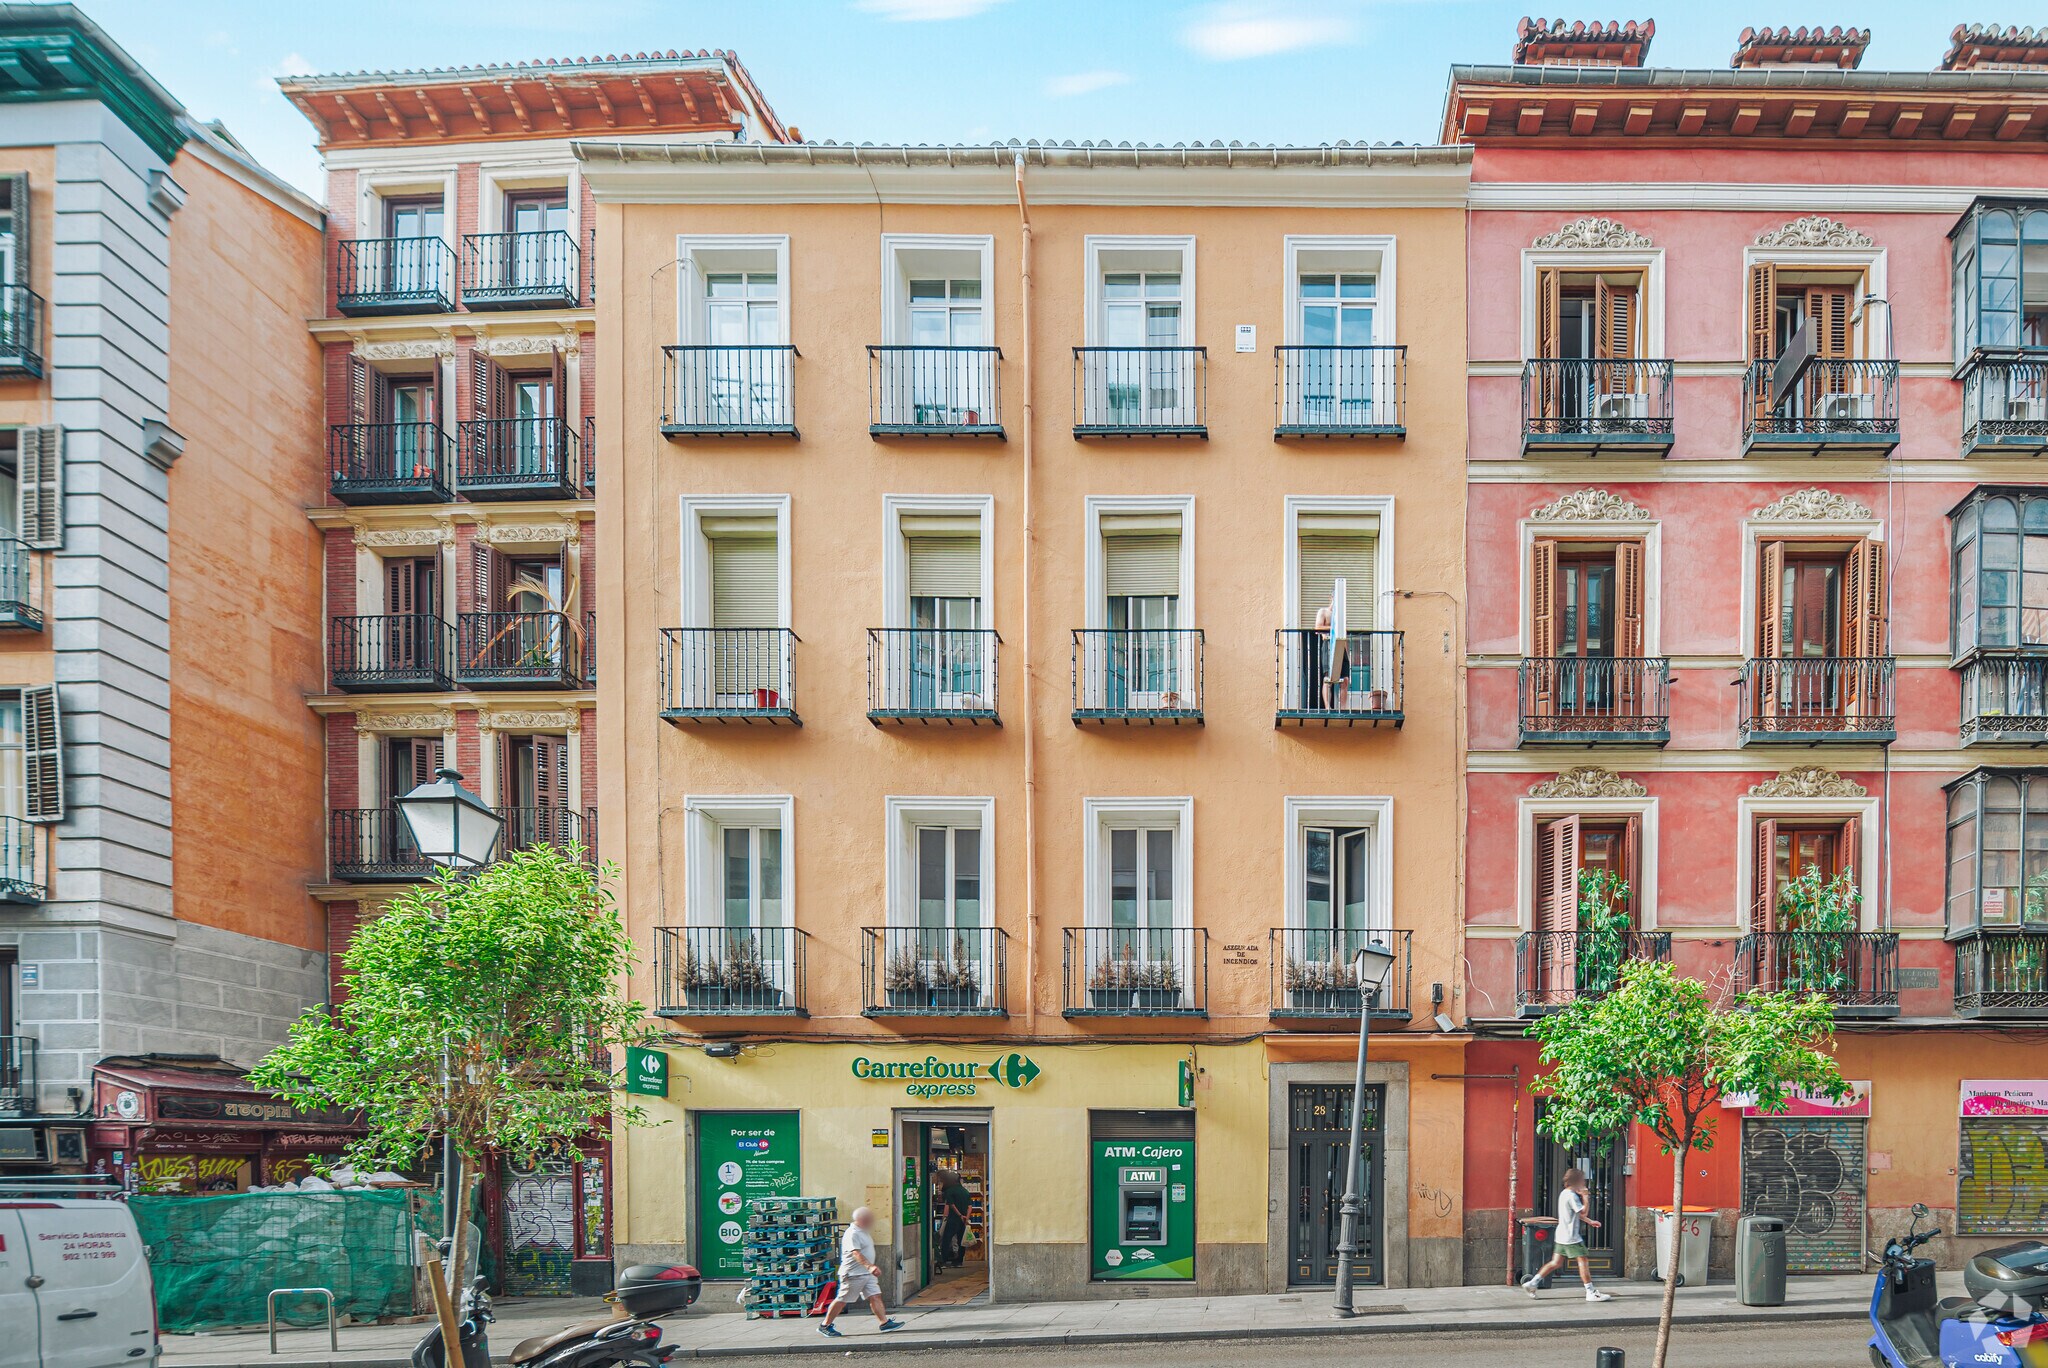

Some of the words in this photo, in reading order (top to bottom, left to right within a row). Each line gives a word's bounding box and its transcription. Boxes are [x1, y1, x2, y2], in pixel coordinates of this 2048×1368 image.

[851, 1055, 979, 1079] Carrefour
[906, 1082, 977, 1099] express
[1313, 1105, 1326, 1116] 28
[763, 1128, 775, 1136] de
[1104, 1147, 1136, 1158] ATM
[1141, 1145, 1183, 1159] Cajero
[1130, 1171, 1156, 1181] ATM
[38, 1232, 80, 1241] Servicio
[82, 1231, 127, 1240] Asistencia
[720, 1228, 740, 1237] BIO
[63, 1242, 76, 1250] 24
[77, 1241, 112, 1249] HORAS
[62, 1253, 80, 1261] 902
[1974, 1352, 2003, 1365] cabify
